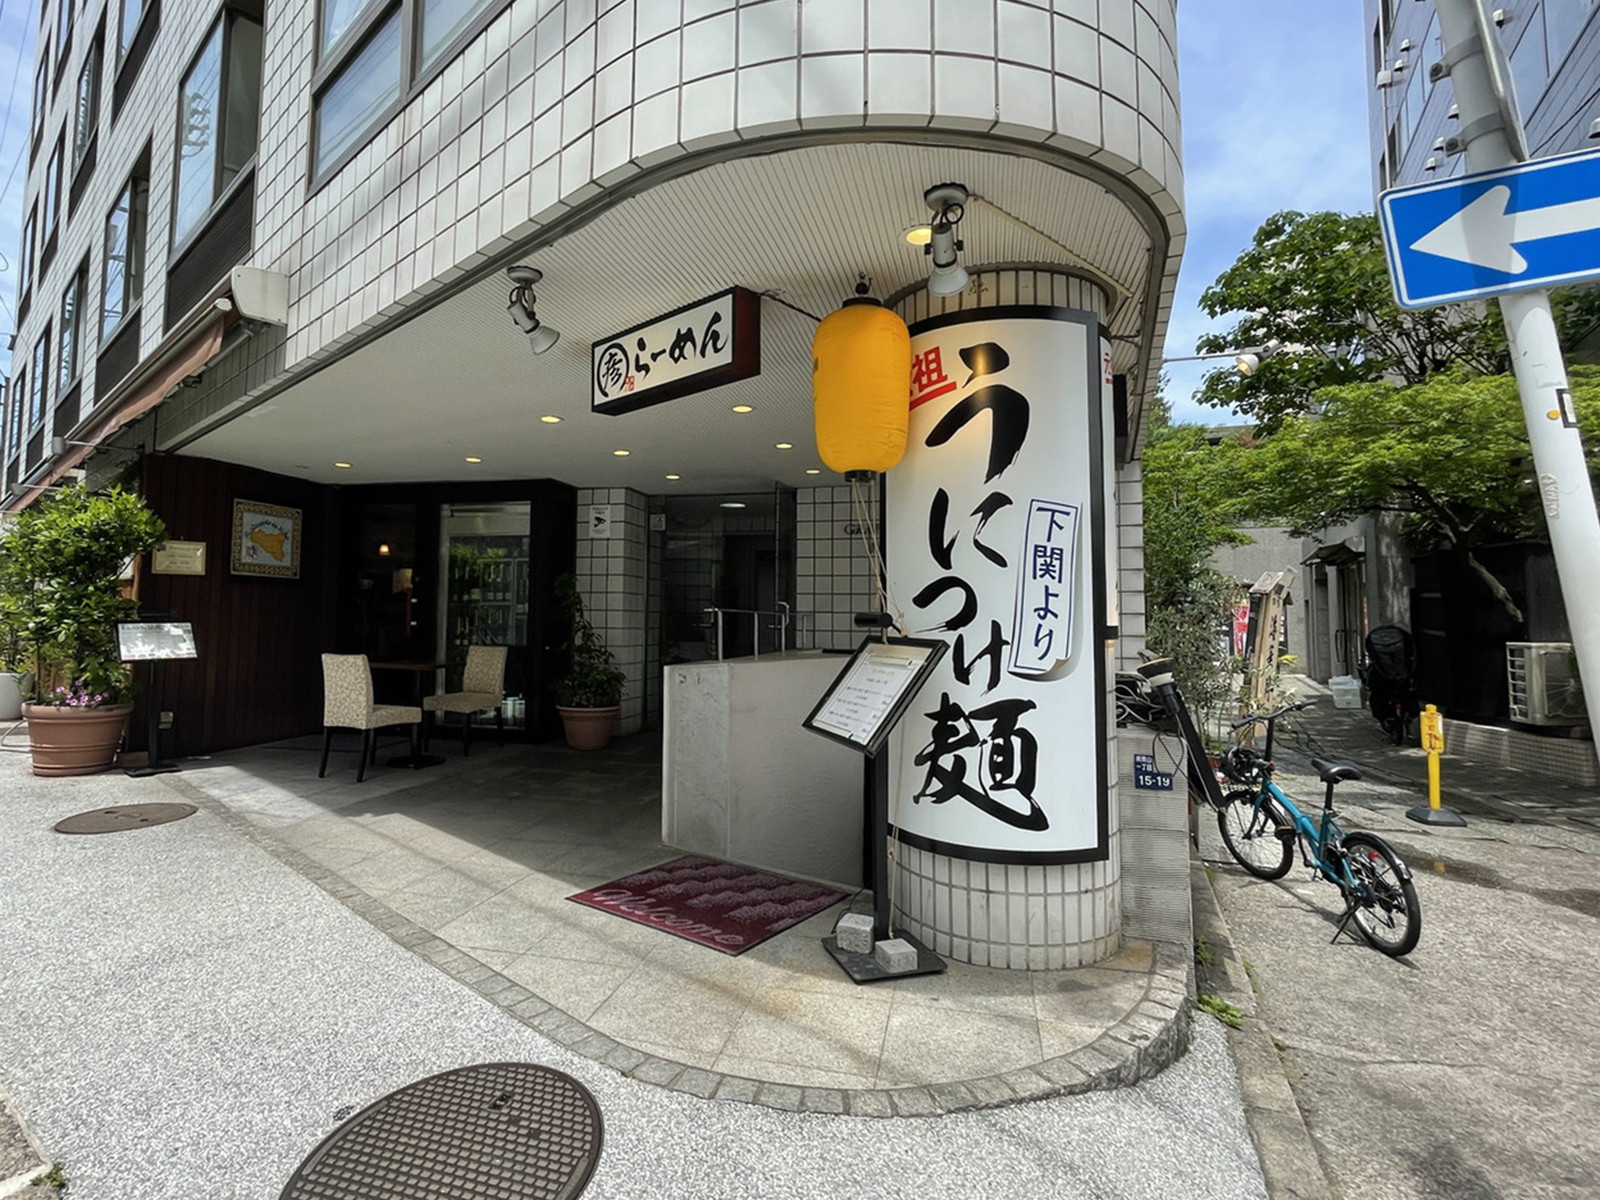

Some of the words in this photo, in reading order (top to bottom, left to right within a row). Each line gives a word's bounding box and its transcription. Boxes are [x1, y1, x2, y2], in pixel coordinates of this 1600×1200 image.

[634, 311, 728, 380] らーめん
[909, 346, 948, 397] 祖
[912, 341, 1050, 832] うにつけ麺
[1032, 506, 1071, 661] 下関より
[1138, 775, 1170, 787] 15-19
[593, 889, 744, 945] Welcome
